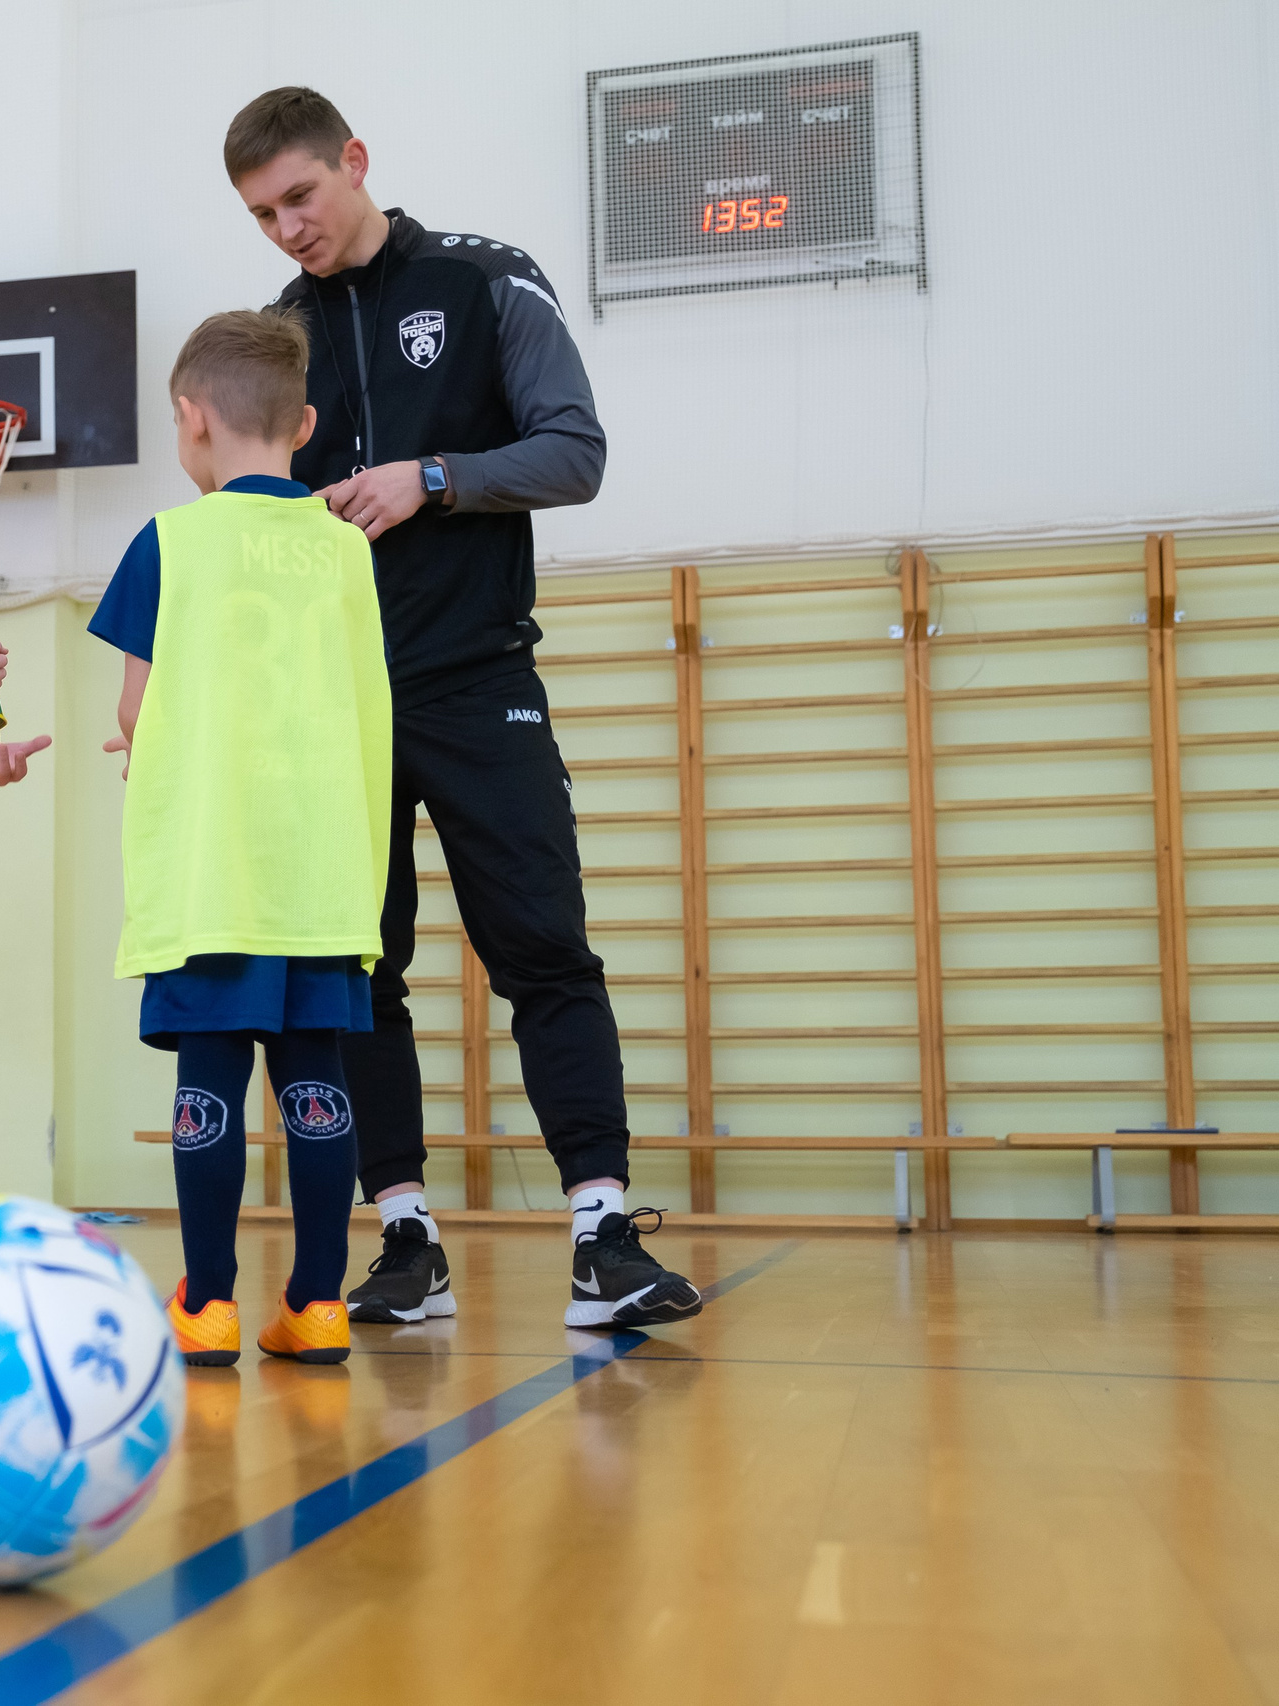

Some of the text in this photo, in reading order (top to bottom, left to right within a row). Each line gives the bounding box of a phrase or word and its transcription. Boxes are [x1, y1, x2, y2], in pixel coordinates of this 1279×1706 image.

[702, 195, 789, 233] 1352
[402, 323, 442, 339] ТОСНО
[506, 709, 542, 723] JAKO
[176, 1093, 211, 1107] ARIS
[288, 1087, 334, 1100] PARIS
